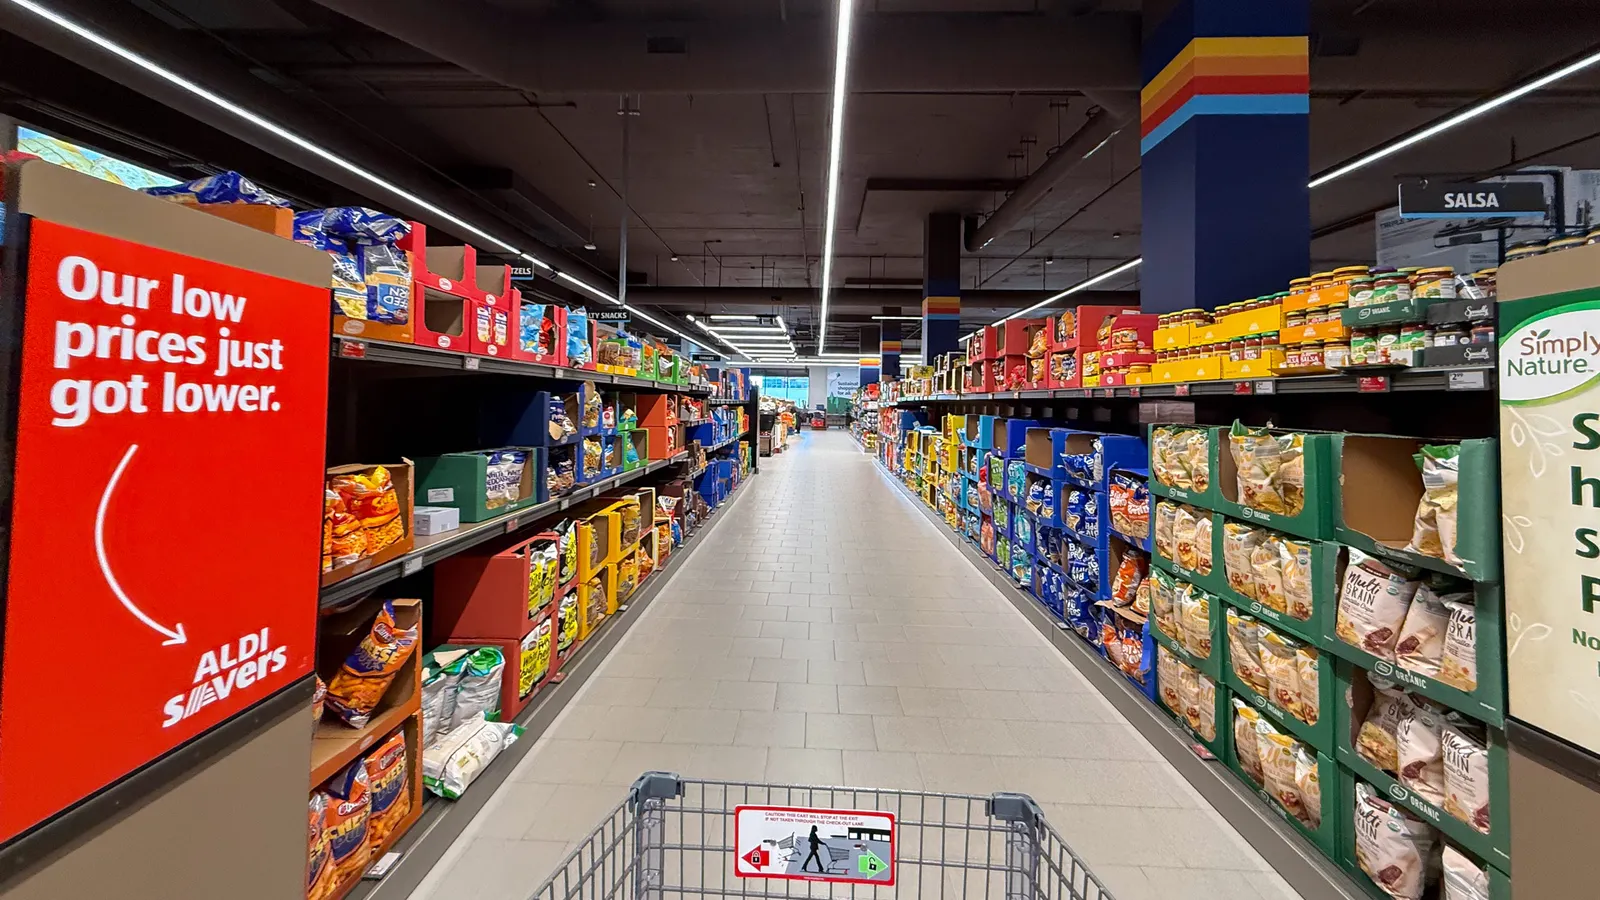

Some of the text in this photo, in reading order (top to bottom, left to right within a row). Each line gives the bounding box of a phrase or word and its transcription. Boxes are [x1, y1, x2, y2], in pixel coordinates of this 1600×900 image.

[1444, 192, 1499, 208] SALSA
[510, 267, 531, 275] TZELS
[57, 255, 247, 323] Our low
[53, 314, 284, 377] prices just
[50, 371, 282, 428] got lower.
[1345, 583, 1375, 606] GRAIN
[1348, 570, 1382, 595] Multi
[1449, 619, 1473, 641] GRA
[192, 627, 270, 684] ALDI
[1395, 669, 1427, 690] ORGANIC
[1409, 795, 1440, 822] ORGANIC
